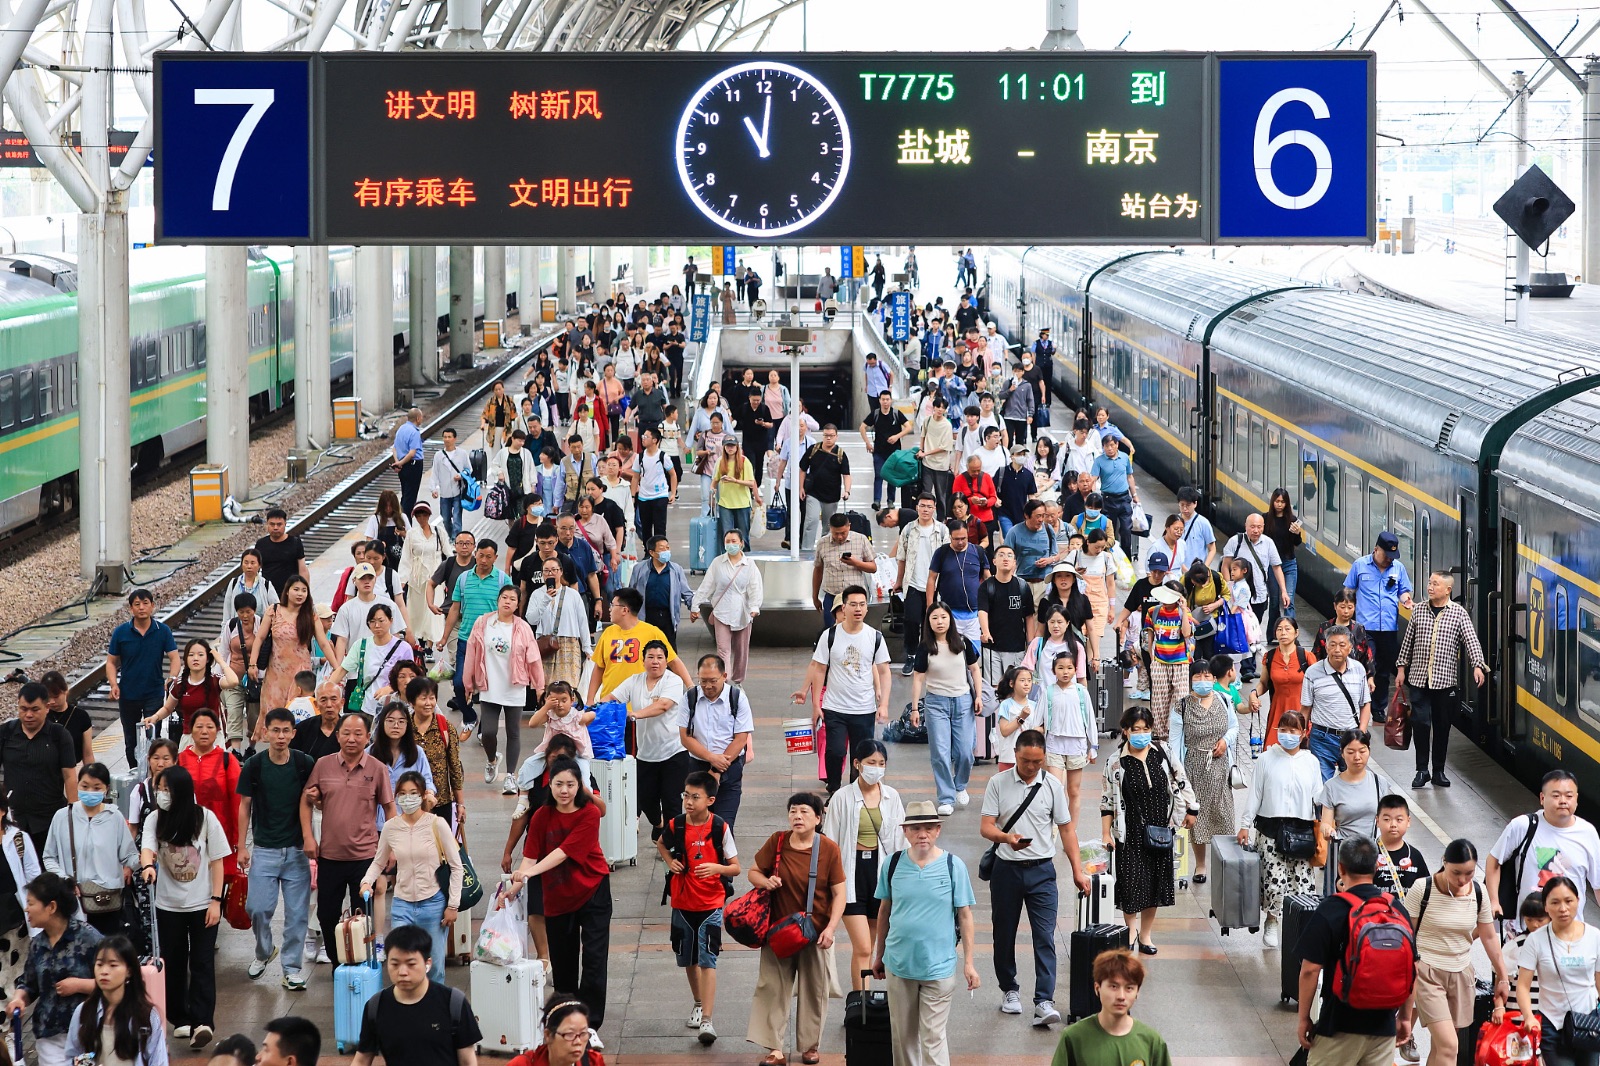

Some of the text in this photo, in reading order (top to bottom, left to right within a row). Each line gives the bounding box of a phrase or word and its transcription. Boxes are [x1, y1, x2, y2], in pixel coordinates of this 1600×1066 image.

[756, 82, 772, 94] 12
[859, 70, 1166, 106] T7775 11:01 到
[725, 89, 740, 102] 11
[790, 89, 797, 102] 1
[385, 90, 602, 119] 讲文明 树新风
[704, 112, 719, 125] 10
[812, 112, 820, 125] 2
[194, 89, 274, 210] 7
[698, 142, 707, 155] 9
[820, 142, 828, 155] 3
[897, 128, 971, 164] 盐城
[1087, 128, 1159, 165] 南京
[1254, 87, 1332, 210] 6
[706, 173, 715, 186] 8
[811, 172, 820, 184] 4
[354, 178, 632, 207] 有序乘车 文明出行
[729, 195, 738, 207] 7
[790, 195, 799, 207] 5
[1121, 193, 1198, 219] 站台为
[760, 204, 768, 216] 6
[693, 296, 706, 340] 旅客止步
[895, 294, 907, 339] 旅客止步
[1156, 619, 1181, 627] CHINA
[610, 638, 640, 664] 23
